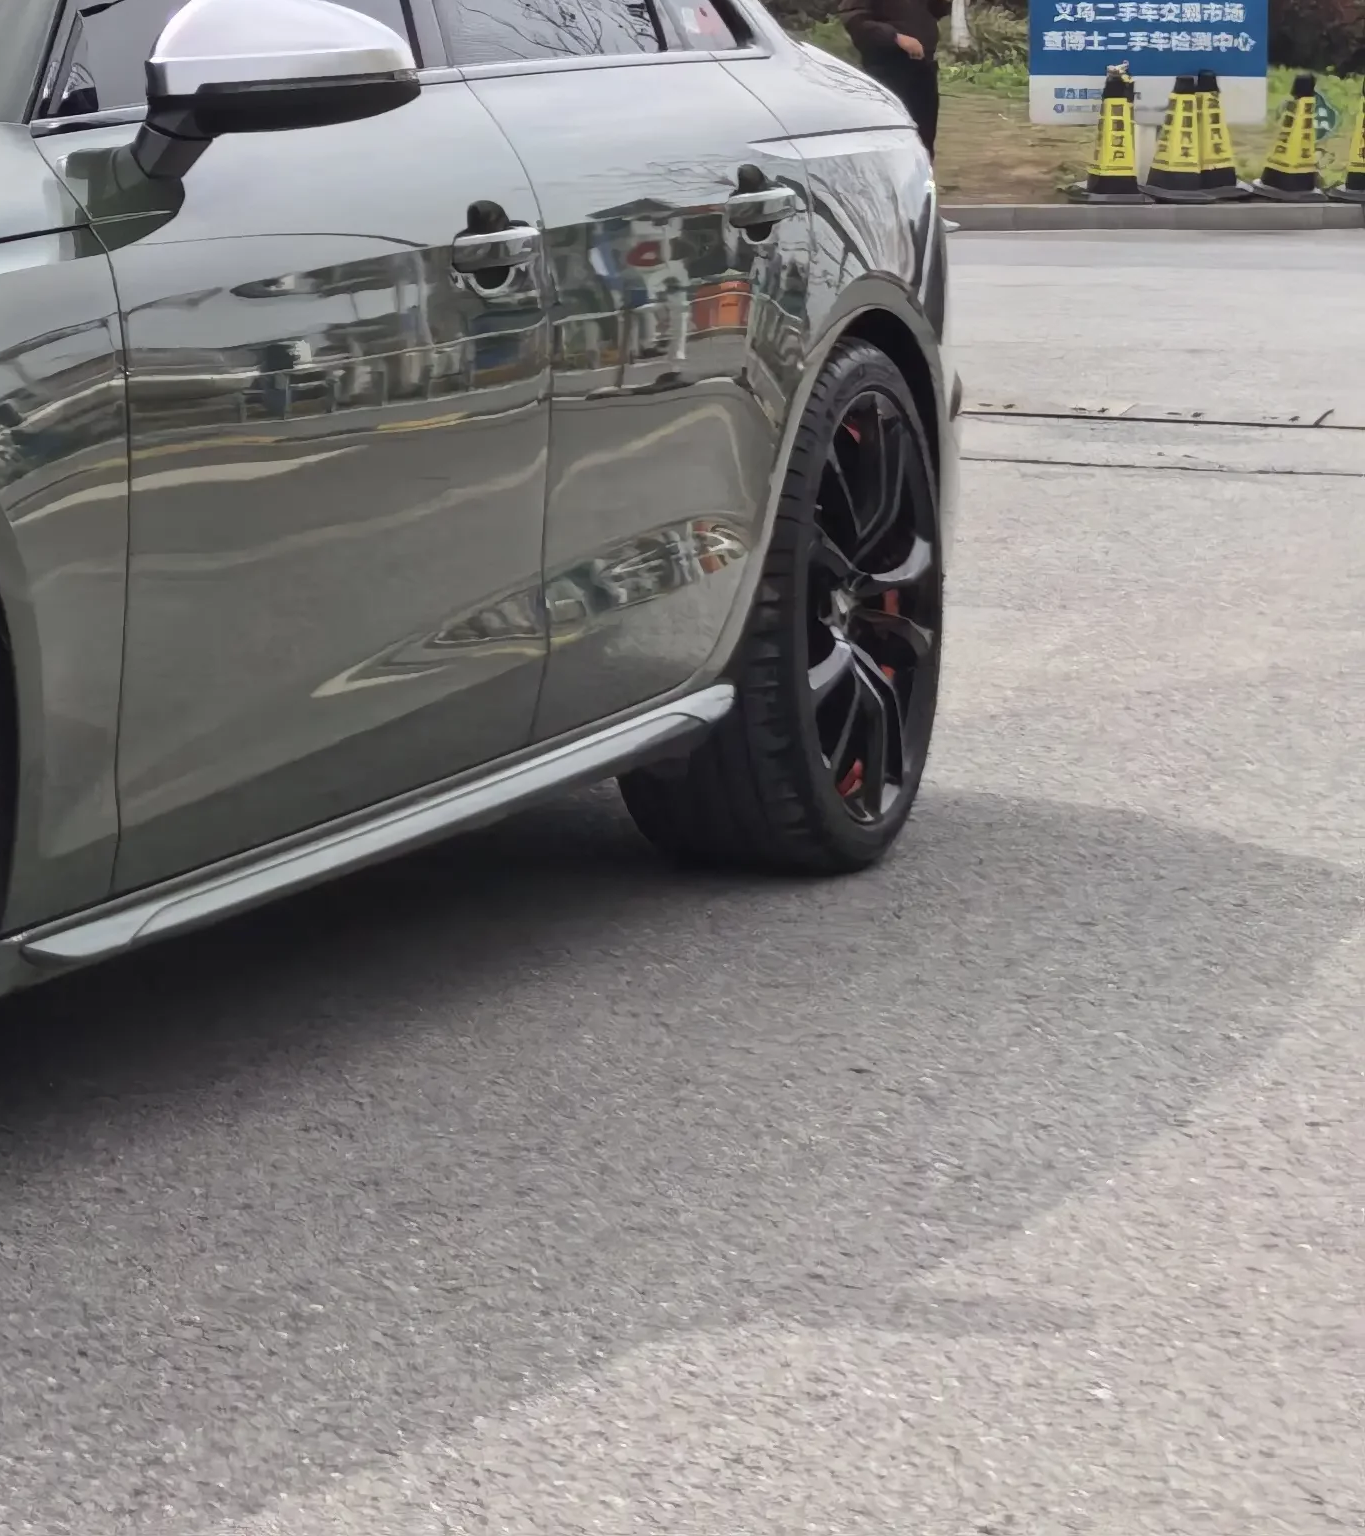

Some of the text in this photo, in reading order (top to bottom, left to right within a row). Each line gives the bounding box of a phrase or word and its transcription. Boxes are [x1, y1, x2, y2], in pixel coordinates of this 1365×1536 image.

[1054, 2, 1246, 23] 义乌二手车交易市场
